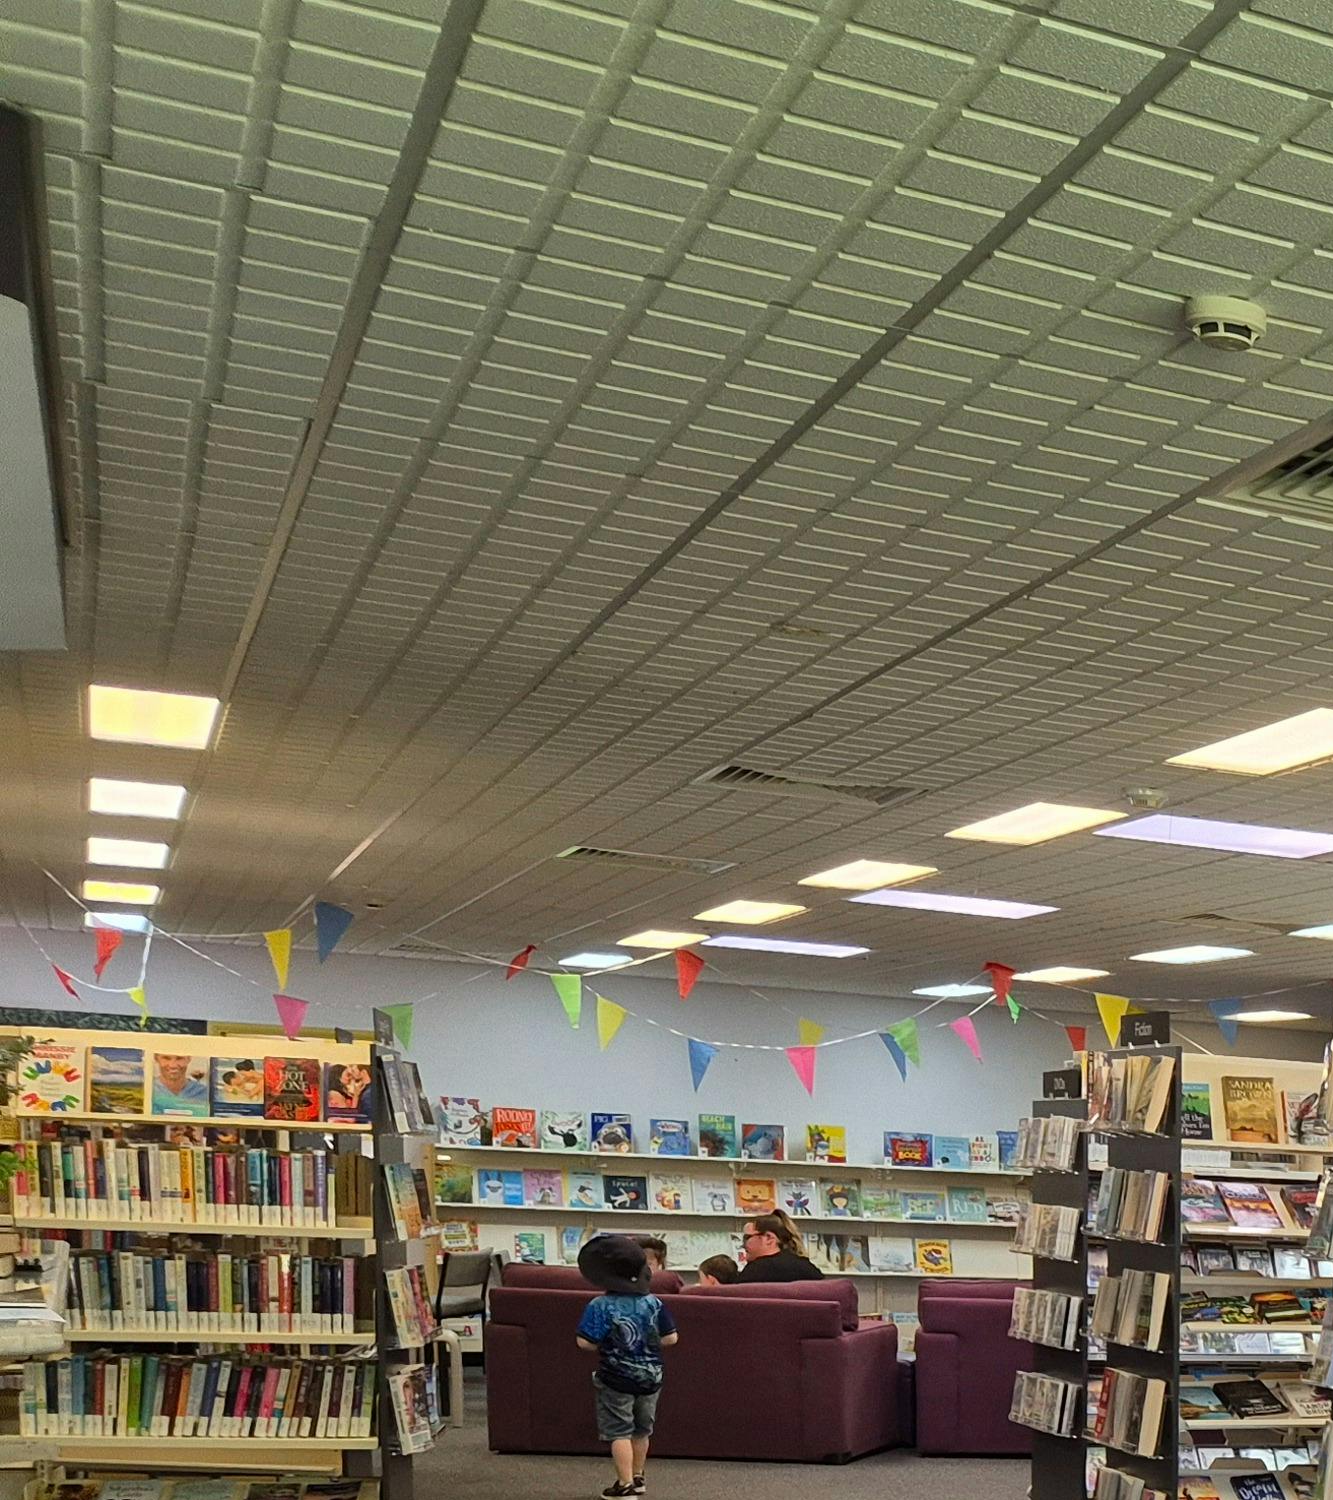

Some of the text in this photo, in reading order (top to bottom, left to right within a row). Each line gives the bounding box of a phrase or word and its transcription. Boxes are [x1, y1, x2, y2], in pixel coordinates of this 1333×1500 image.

[1134, 1021, 1153, 1037] Fiction
[279, 1070, 306, 1082] HOT
[1229, 1078, 1274, 1090] SANDRA
